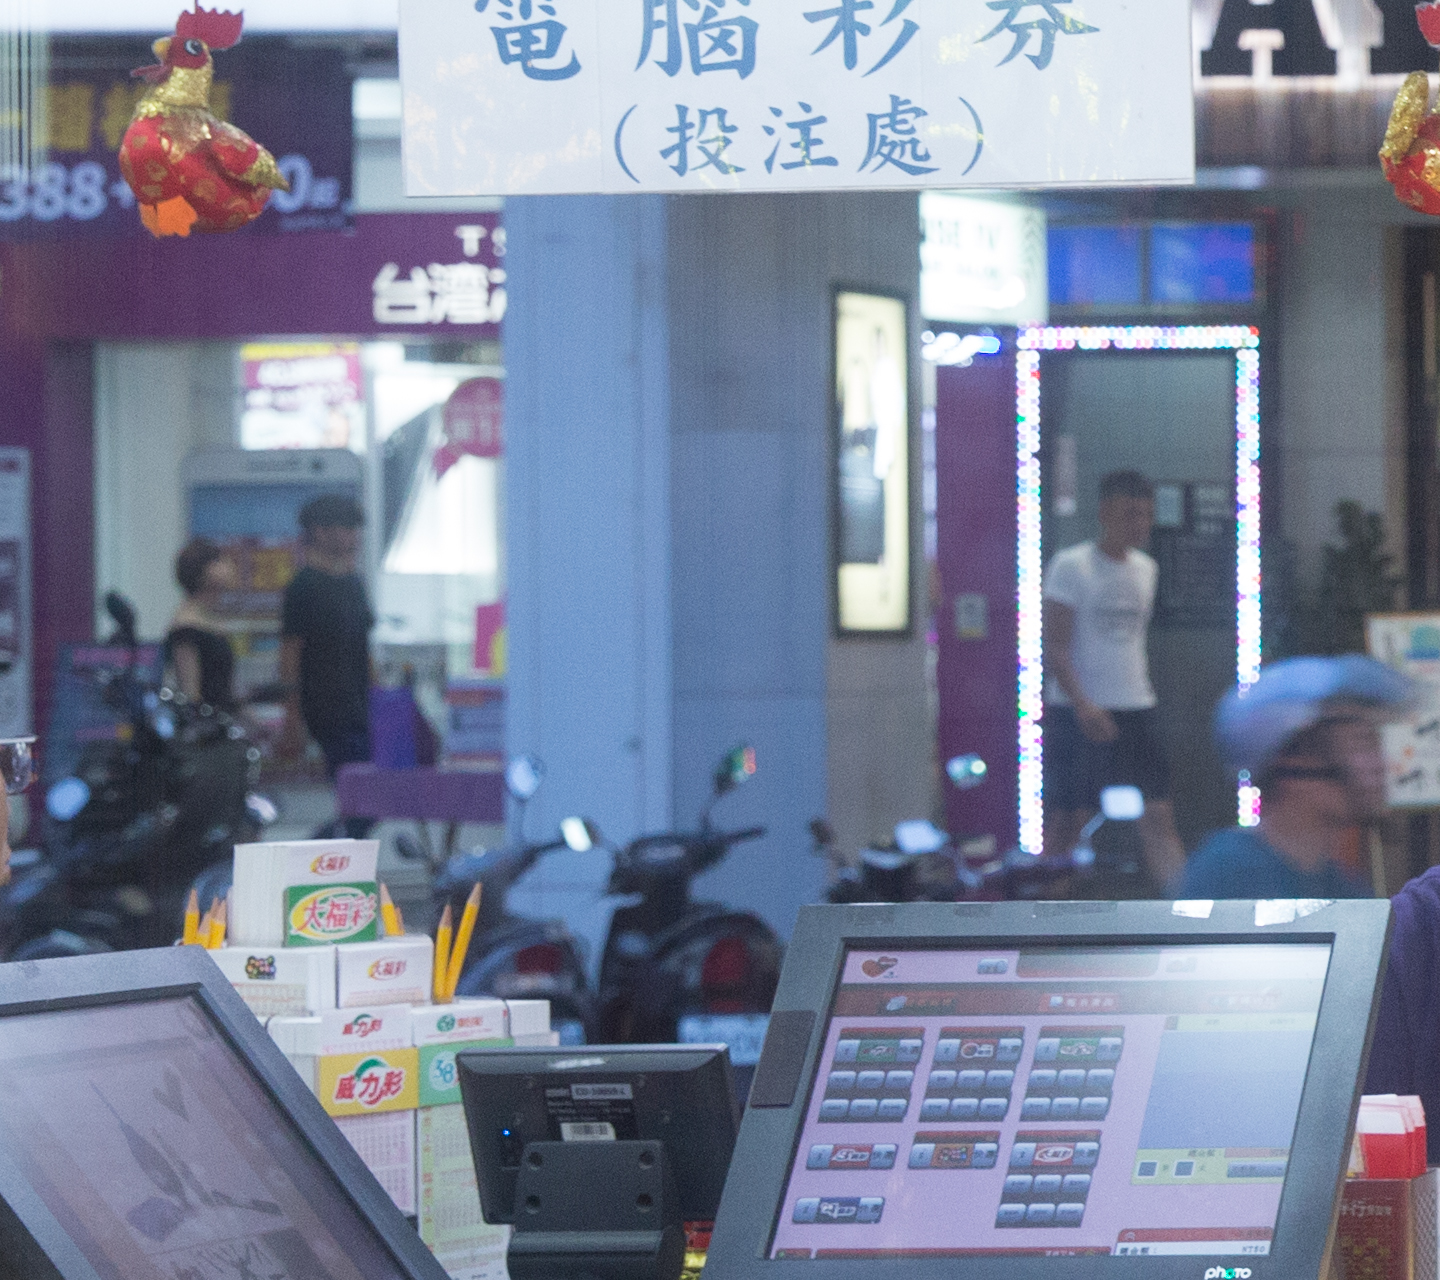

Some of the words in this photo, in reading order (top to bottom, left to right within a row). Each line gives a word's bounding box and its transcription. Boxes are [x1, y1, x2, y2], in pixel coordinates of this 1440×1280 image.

[613, 94, 988, 184] (投注處)
[298, 894, 378, 932] 大福彩
[334, 1067, 404, 1106] 威力彩
